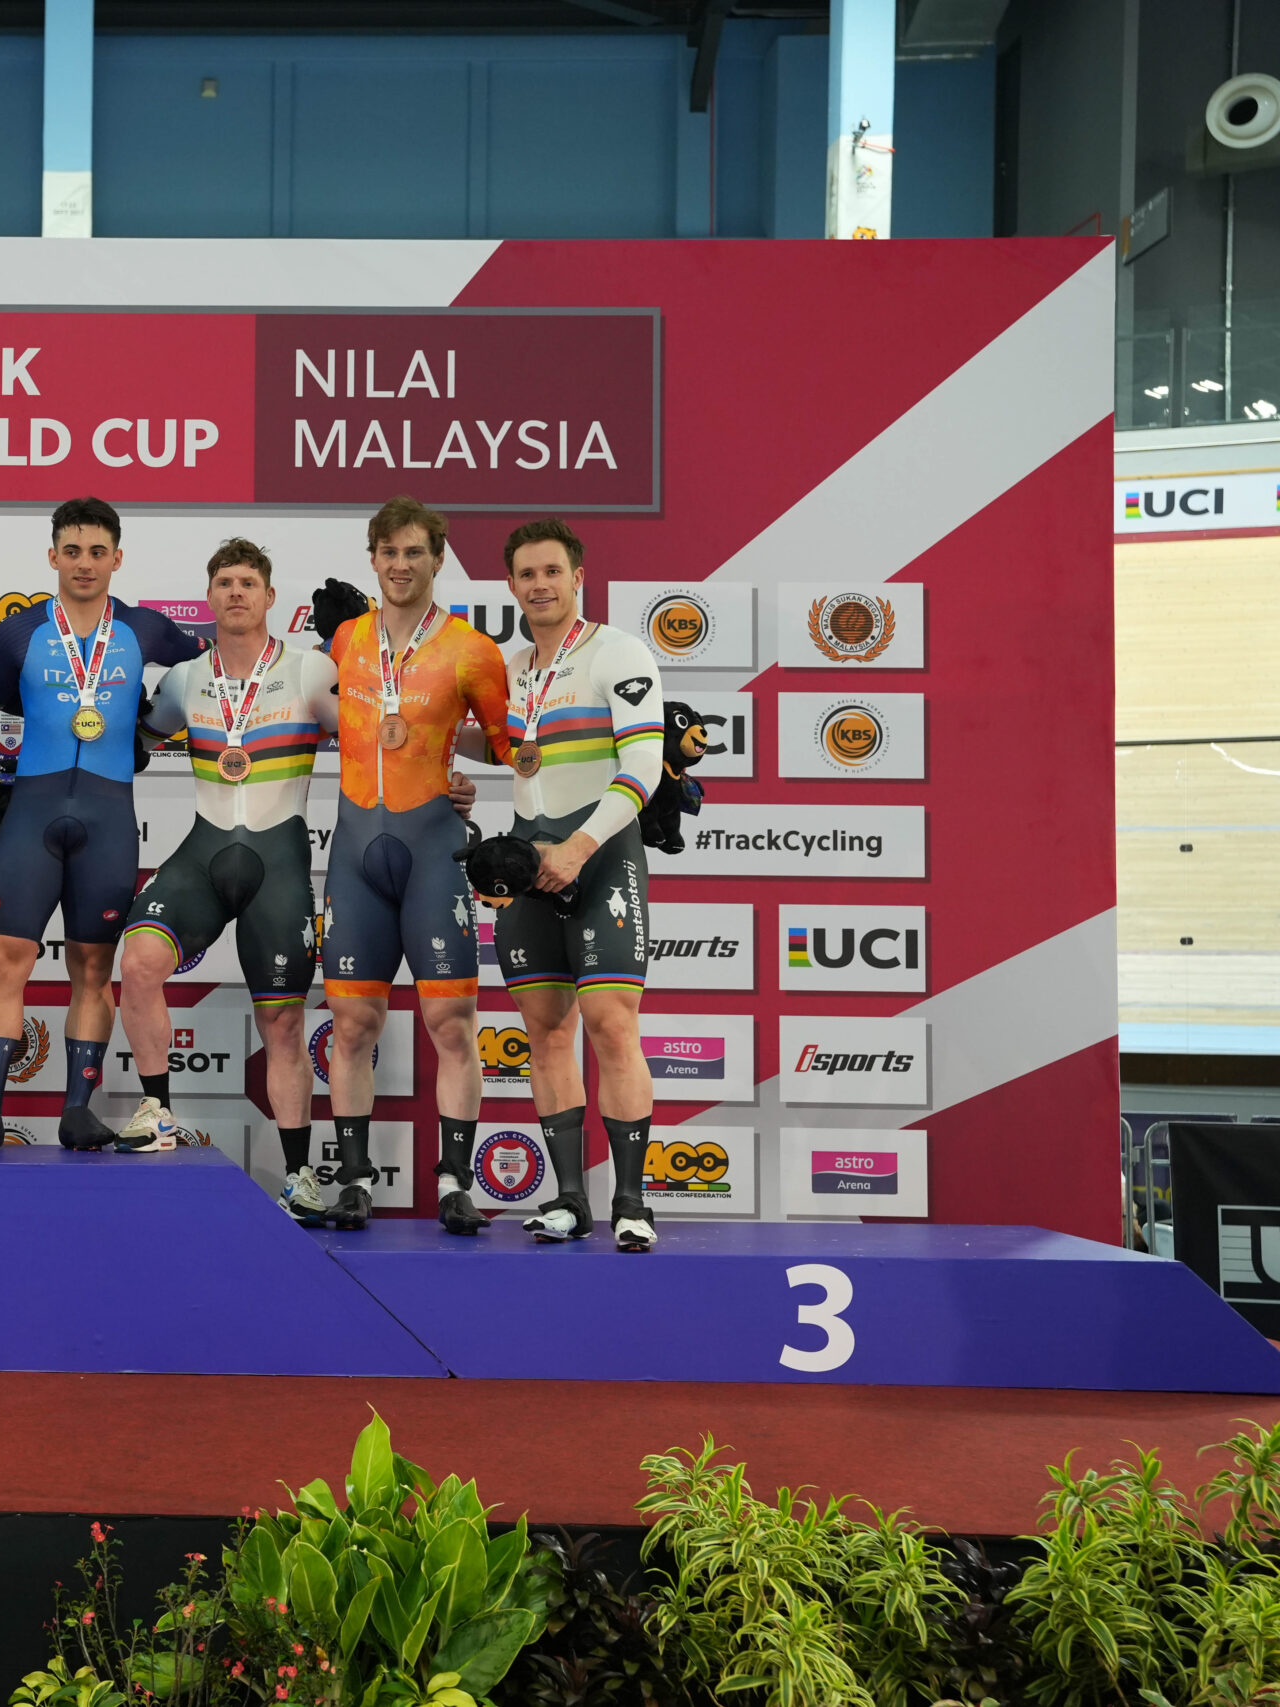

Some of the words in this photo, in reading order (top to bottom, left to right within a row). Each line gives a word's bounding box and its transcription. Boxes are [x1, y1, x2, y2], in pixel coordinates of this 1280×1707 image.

[294, 349, 457, 398] NILAI
[92, 418, 219, 468] CUP
[294, 419, 618, 470] MALAYSIA
[1144, 487, 1224, 517] UCI
[161, 604, 198, 617] astro
[823, 603, 836, 630] MAJLIS
[836, 595, 863, 605] SUKAN
[863, 600, 880, 629] NEGARA
[666, 618, 698, 633] KBS
[833, 640, 871, 651] MALAYSIA
[44, 666, 126, 684] ITAIA
[57, 691, 112, 703] evso
[192, 707, 292, 729] Staaoterij
[840, 729, 872, 743] KBS
[695, 829, 883, 858] #TrackCycling
[812, 928, 918, 970] UCI
[663, 1040, 702, 1054] astro
[116, 1052, 231, 1073] TSOT
[665, 1064, 699, 1075] Arena
[794, 1044, 914, 1075] isports
[477, 1133, 508, 1159] NATIONAL
[512, 1133, 541, 1157] CYCLING
[835, 1154, 874, 1170] astro
[476, 1162, 504, 1199] MALAYSIAN
[514, 1161, 543, 1199] FEDERATION
[837, 1179, 871, 1191] Arena
[675, 1191, 732, 1199] CONFEDERATION
[779, 1263, 856, 1372] 3
